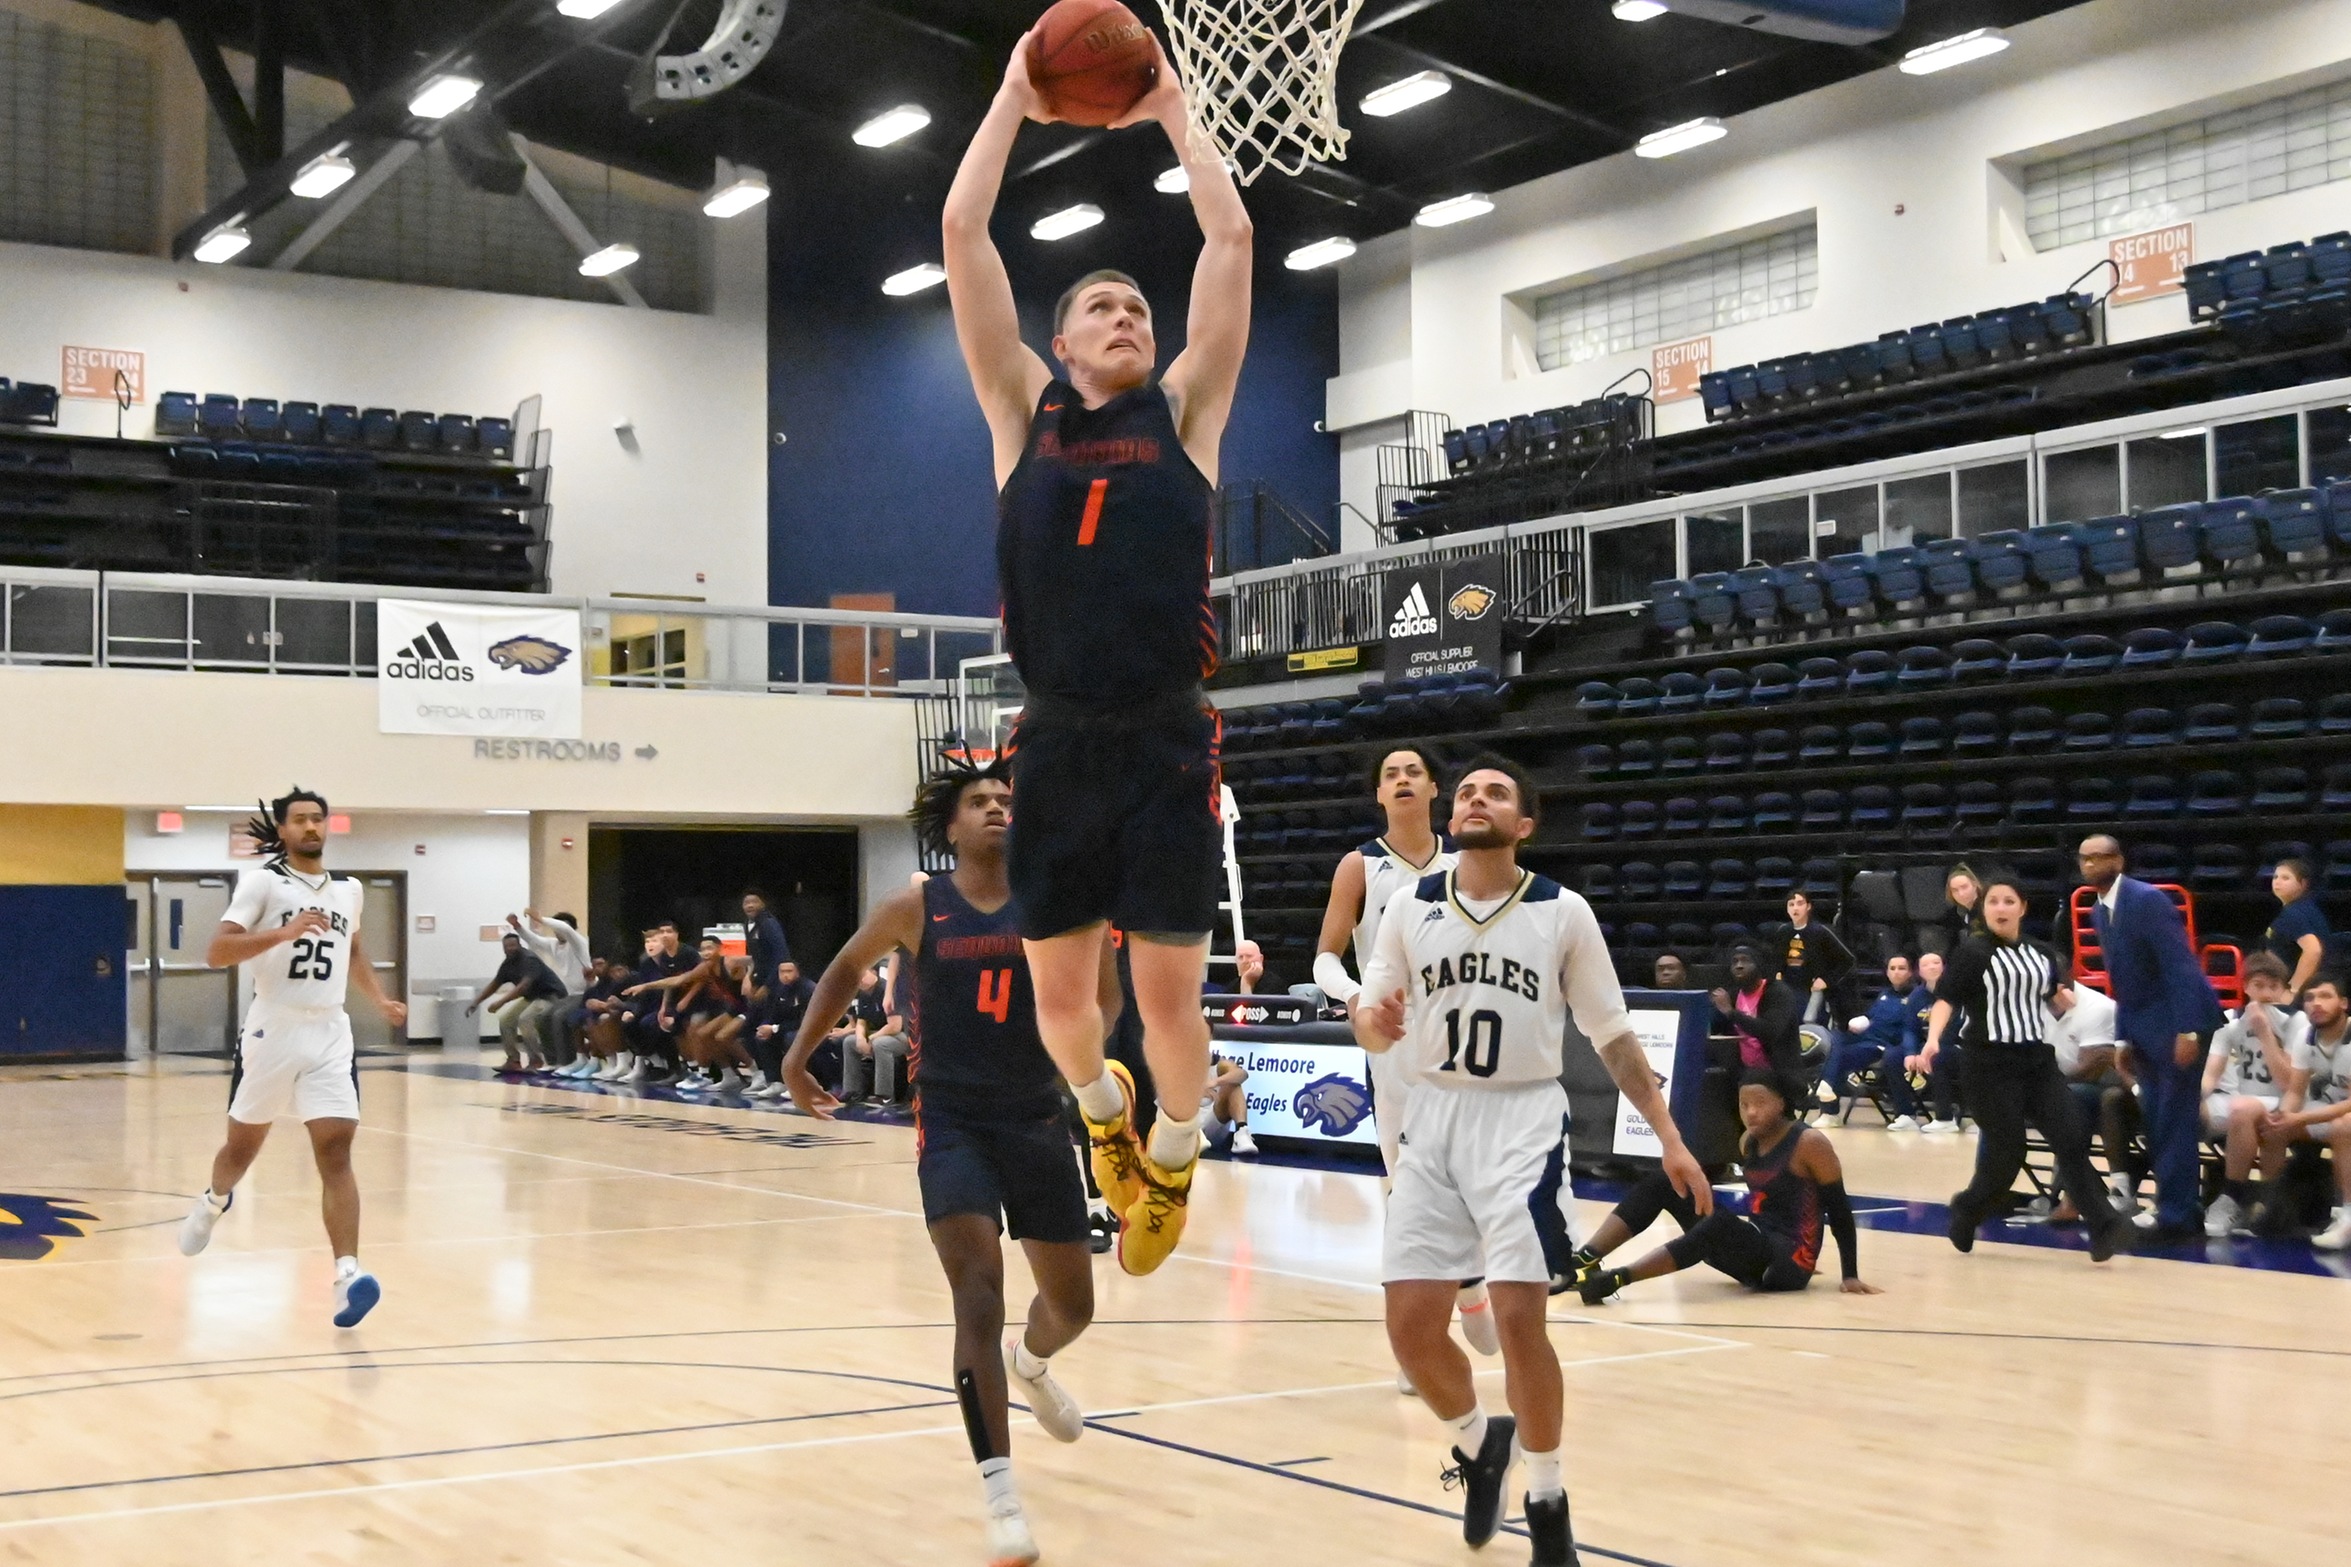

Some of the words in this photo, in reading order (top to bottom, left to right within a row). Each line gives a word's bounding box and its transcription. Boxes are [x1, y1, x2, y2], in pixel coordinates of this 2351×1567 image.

[2114, 228, 2188, 263] SECTION
[66, 348, 140, 371] SECTION
[1656, 340, 1708, 369] SECTION
[66, 367, 86, 385] 23
[1656, 368, 1670, 387] 15
[1077, 479, 1108, 545] 1
[1389, 616, 1438, 639] adidas
[1410, 650, 1440, 664] OFFICIAL
[1440, 646, 1473, 660] SUPPLIER
[387, 658, 474, 682] adidas
[1405, 667, 1424, 678] WEST
[417, 704, 473, 719] OFFICIAL
[478, 706, 546, 721] OUTFITTER
[474, 738, 621, 761] RESTROOMS
[288, 938, 334, 980] 25
[1421, 952, 1539, 1002] EAGLES
[977, 968, 1013, 1023] 4
[1241, 1007, 1261, 1021] POSS
[1440, 1008, 1502, 1078] 10
[1248, 1051, 1315, 1074] Lemoore
[1246, 1093, 1287, 1115] Eagles
[1626, 1126, 1654, 1136] EAGLES
